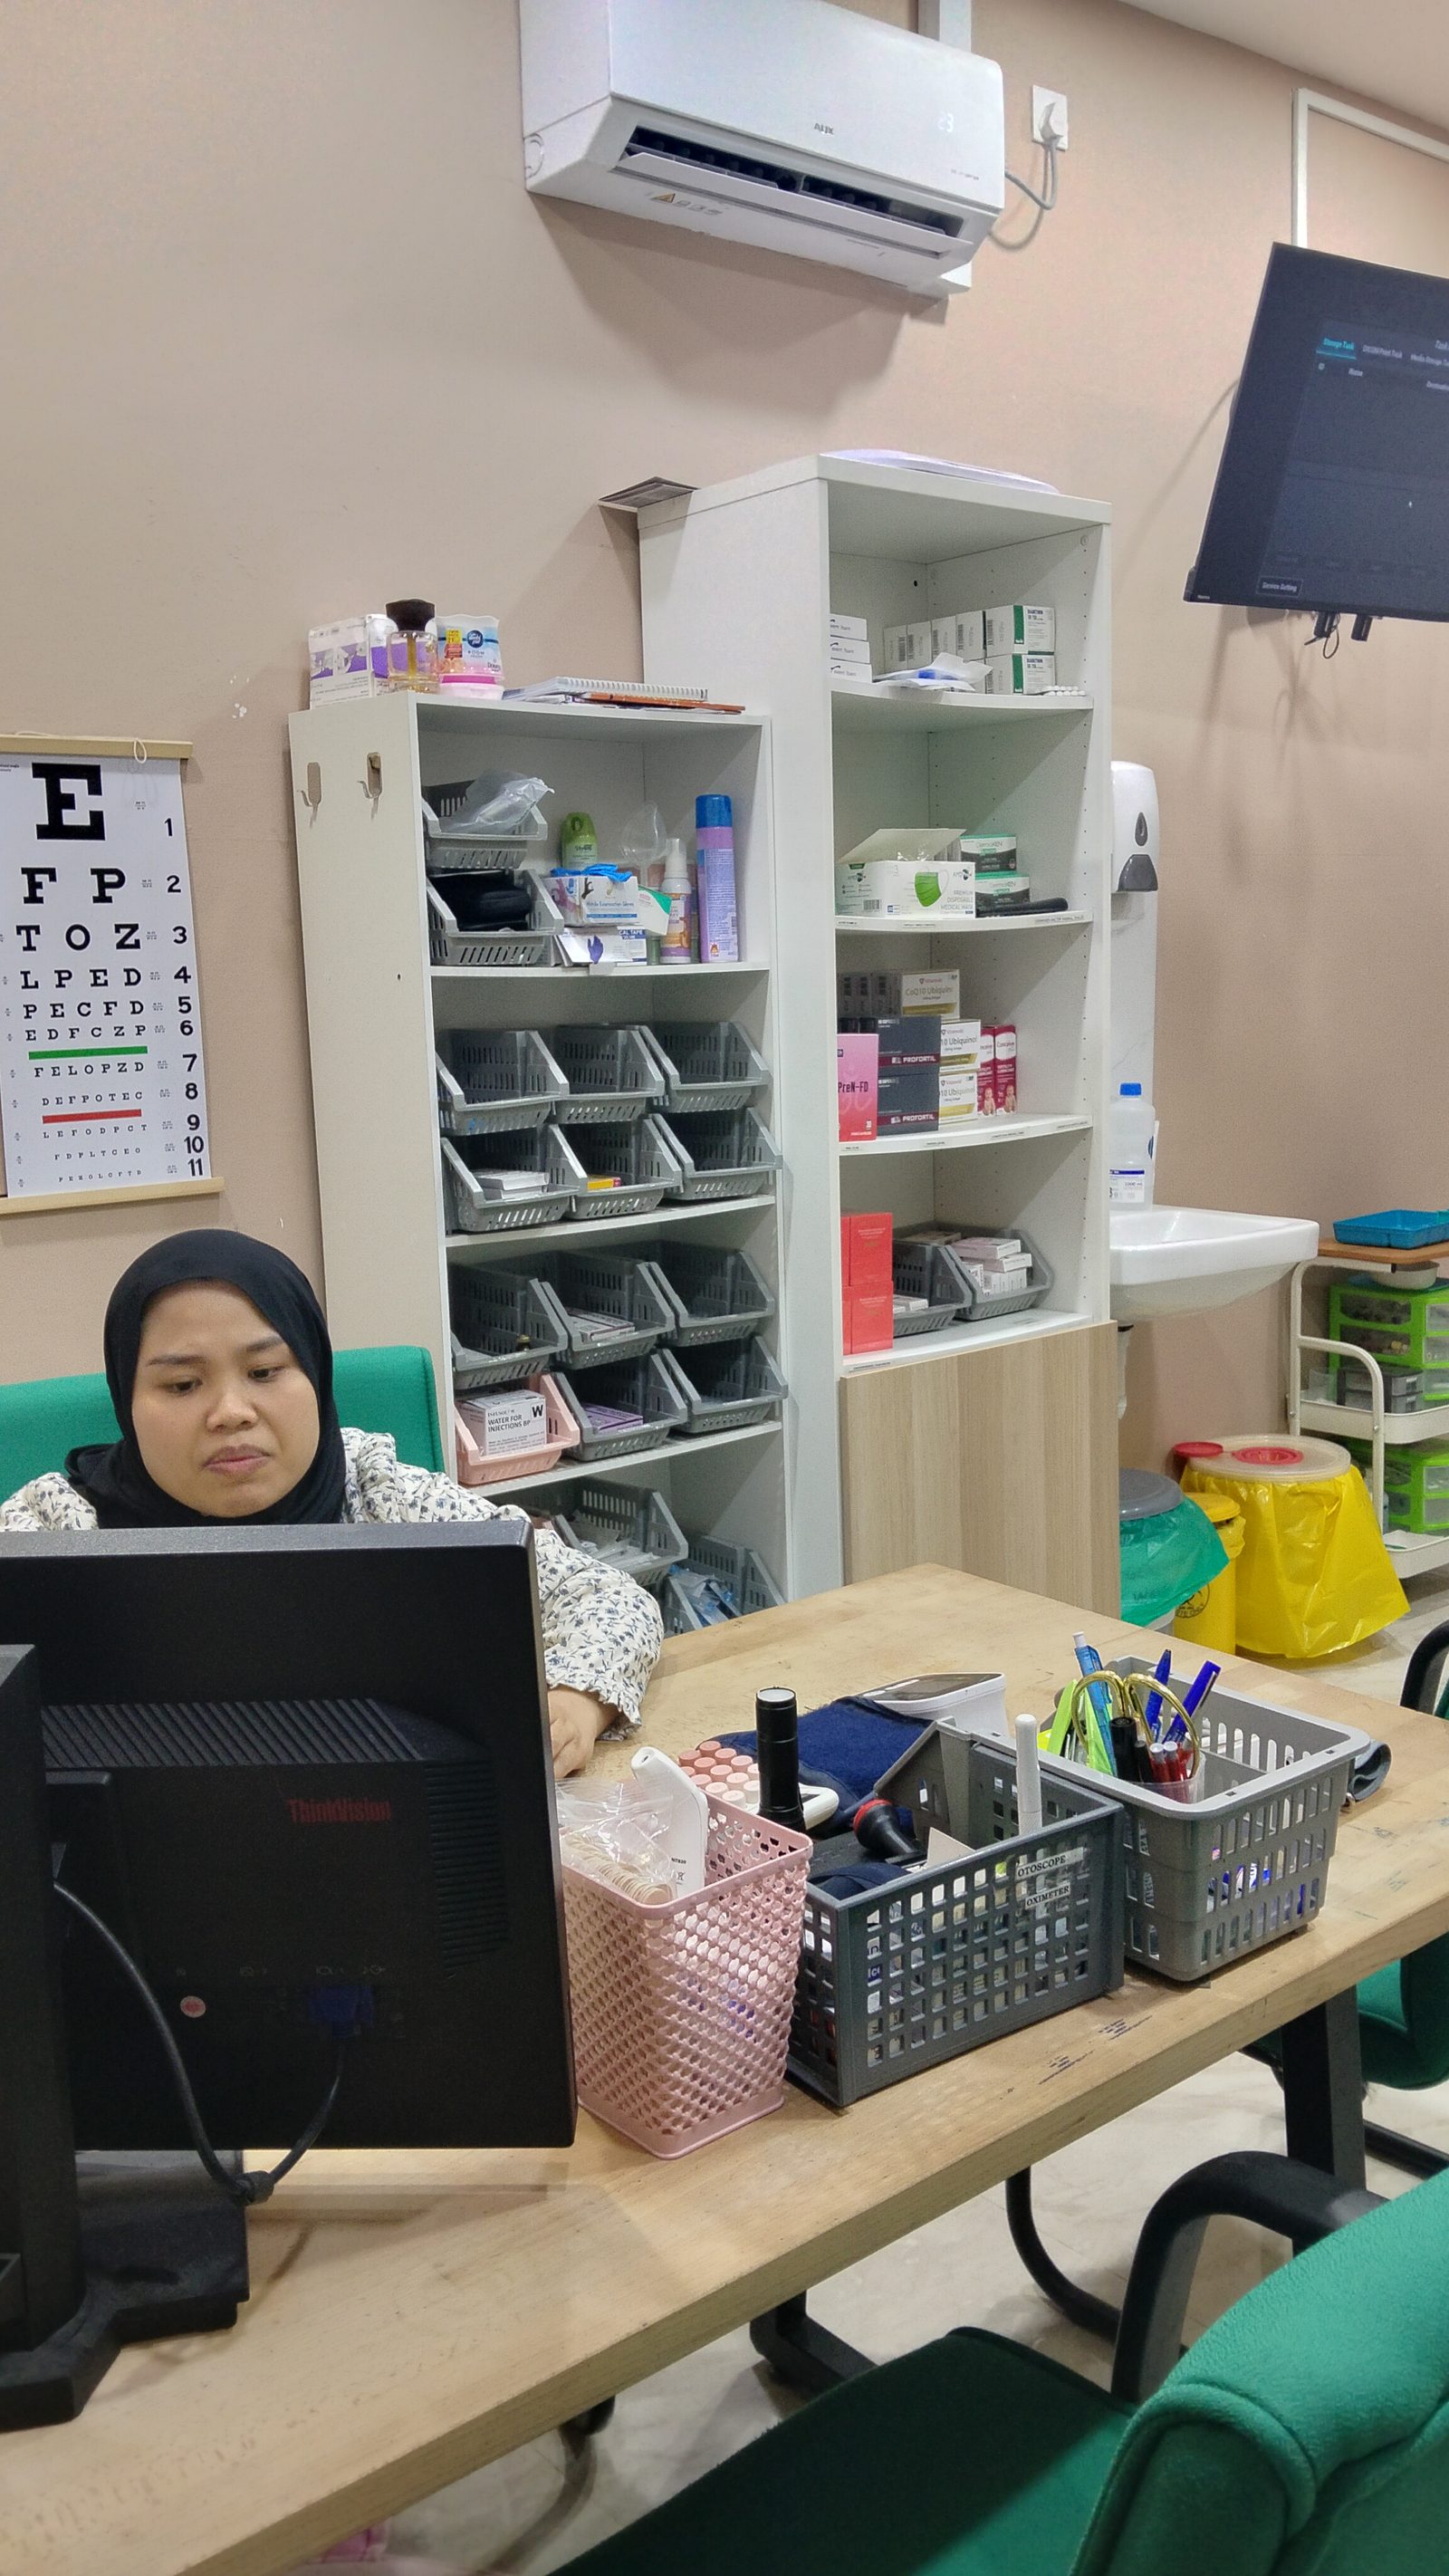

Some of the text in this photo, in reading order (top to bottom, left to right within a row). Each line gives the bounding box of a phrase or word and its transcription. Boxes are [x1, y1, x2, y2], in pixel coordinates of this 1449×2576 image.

[813, 122, 834, 135] AUX
[32, 762, 173, 841] E 1
[167, 875, 181, 893] 2
[173, 926, 187, 944] 3
[174, 966, 191, 984] 4
[178, 996, 192, 1014] 5
[180, 1020, 194, 1036] 6
[182, 1053, 197, 1072] 7
[903, 1054, 936, 1063] PROFORTIL
[185, 1082, 198, 1100] 8
[838, 1082, 869, 1093] PreN-FD
[187, 1114, 200, 1130] 9
[902, 1113, 936, 1122] PROFORTIL
[184, 1136, 205, 1154] 10
[187, 1158, 204, 1177] 11
[487, 1414, 523, 1426] WATER FOR
[532, 1404, 543, 1418] W
[487, 1421, 522, 1433] INJECTIONS
[289, 1798, 392, 1822] ThinkVision
[1017, 1855, 1067, 1878] OTOSCOPE
[1026, 1885, 1070, 1907] OXIMETER
